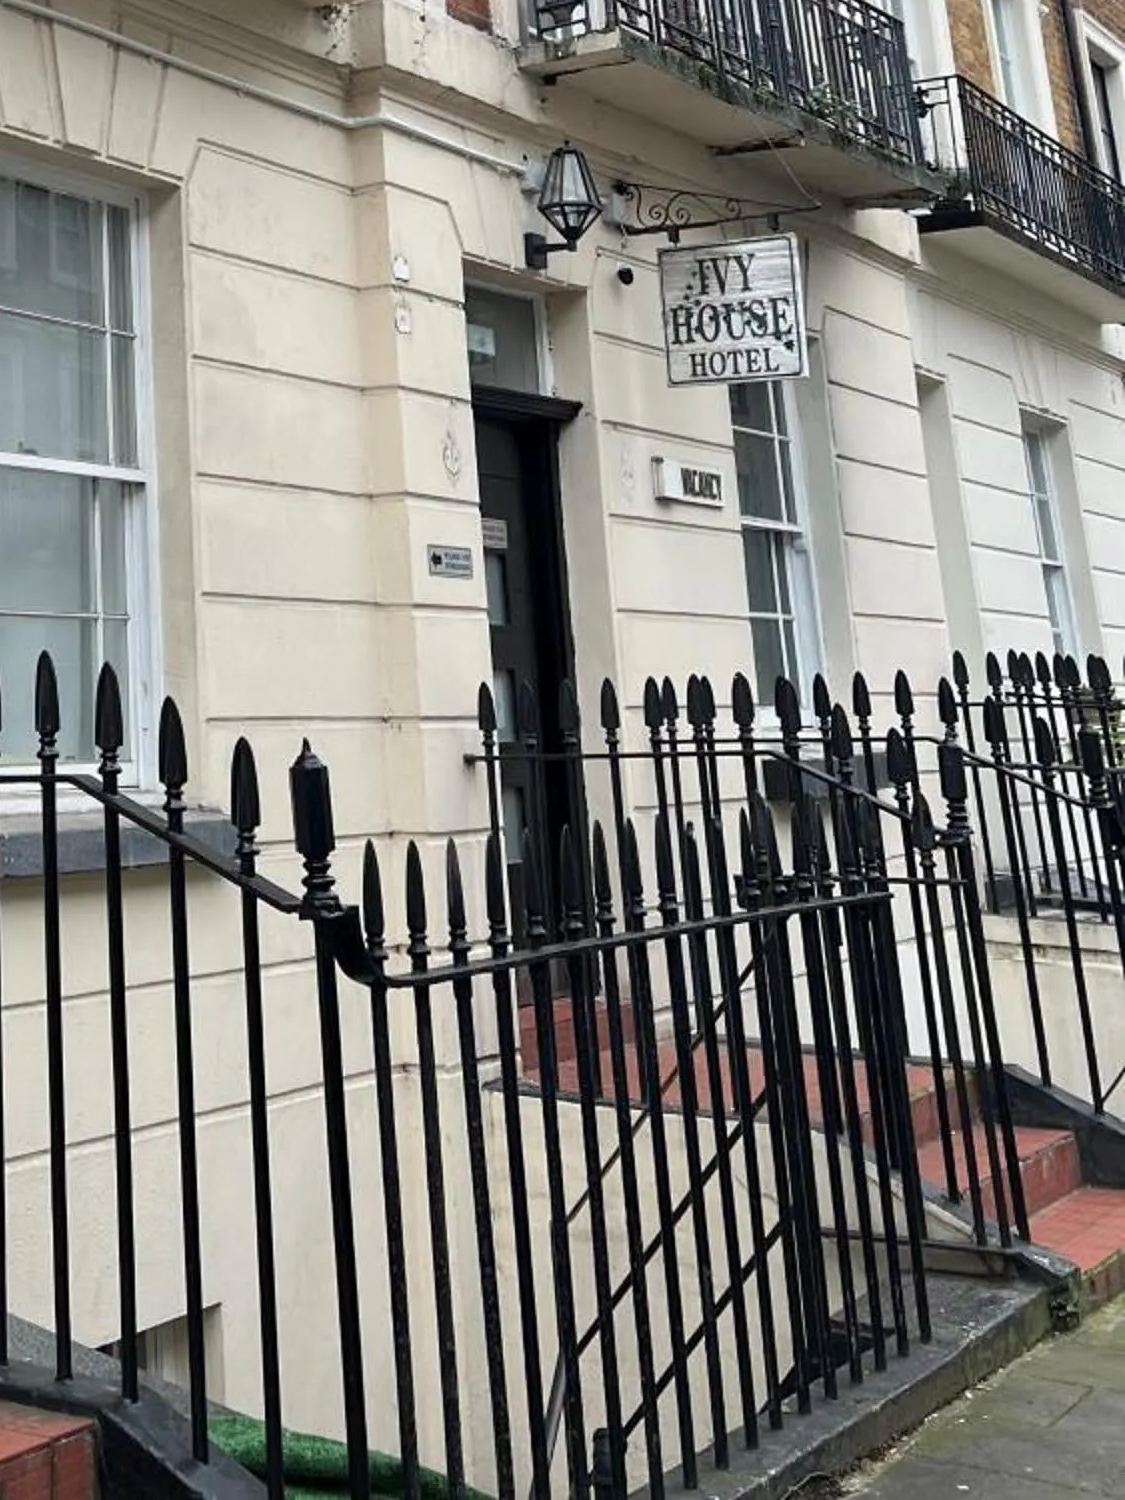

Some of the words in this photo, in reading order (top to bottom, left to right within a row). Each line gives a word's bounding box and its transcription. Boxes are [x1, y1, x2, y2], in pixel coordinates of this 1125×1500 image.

[696, 253, 756, 296] IVY
[670, 297, 793, 345] HOUSE
[689, 348, 779, 377] HOTEL
[681, 467, 722, 501] VACANCY
